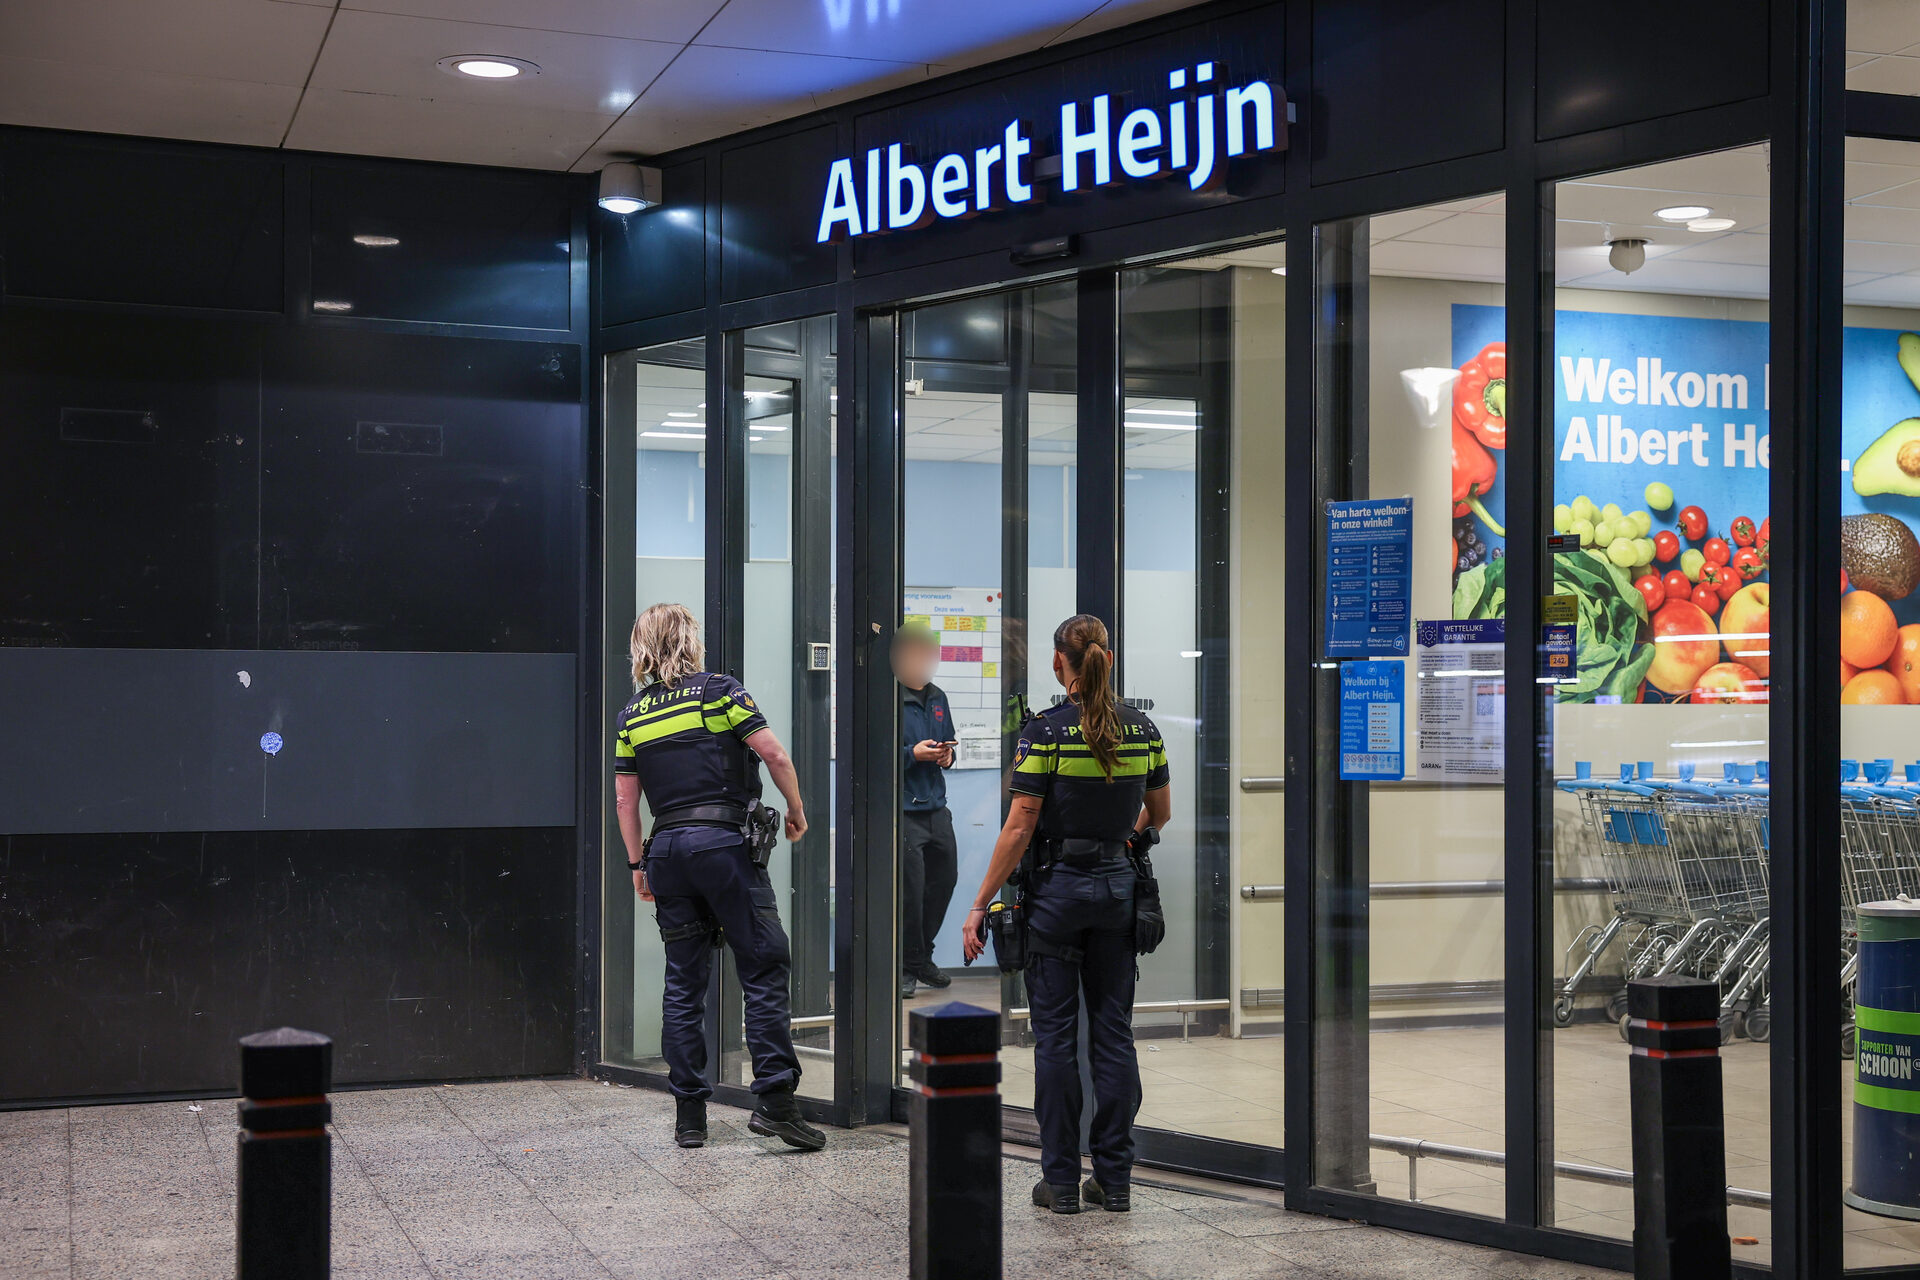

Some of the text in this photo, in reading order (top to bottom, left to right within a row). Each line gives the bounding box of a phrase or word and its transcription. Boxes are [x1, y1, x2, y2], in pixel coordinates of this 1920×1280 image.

[816, 61, 1275, 243] Albert Heijn
[1559, 355, 1748, 409] Welkom
[1559, 414, 1709, 467] Albert
[1331, 505, 1406, 518] Van harte welkom
[1331, 517, 1393, 529] in onze winkel!
[1443, 633, 1476, 641] GARANTIE
[1343, 676, 1389, 688] Welkom bij
[632, 687, 691, 714] POLITIE
[1344, 690, 1396, 701] Albert Heijn.
[1861, 1040, 1911, 1056] SUPPORTER VAN
[1860, 1052, 1912, 1080] SCHOON
